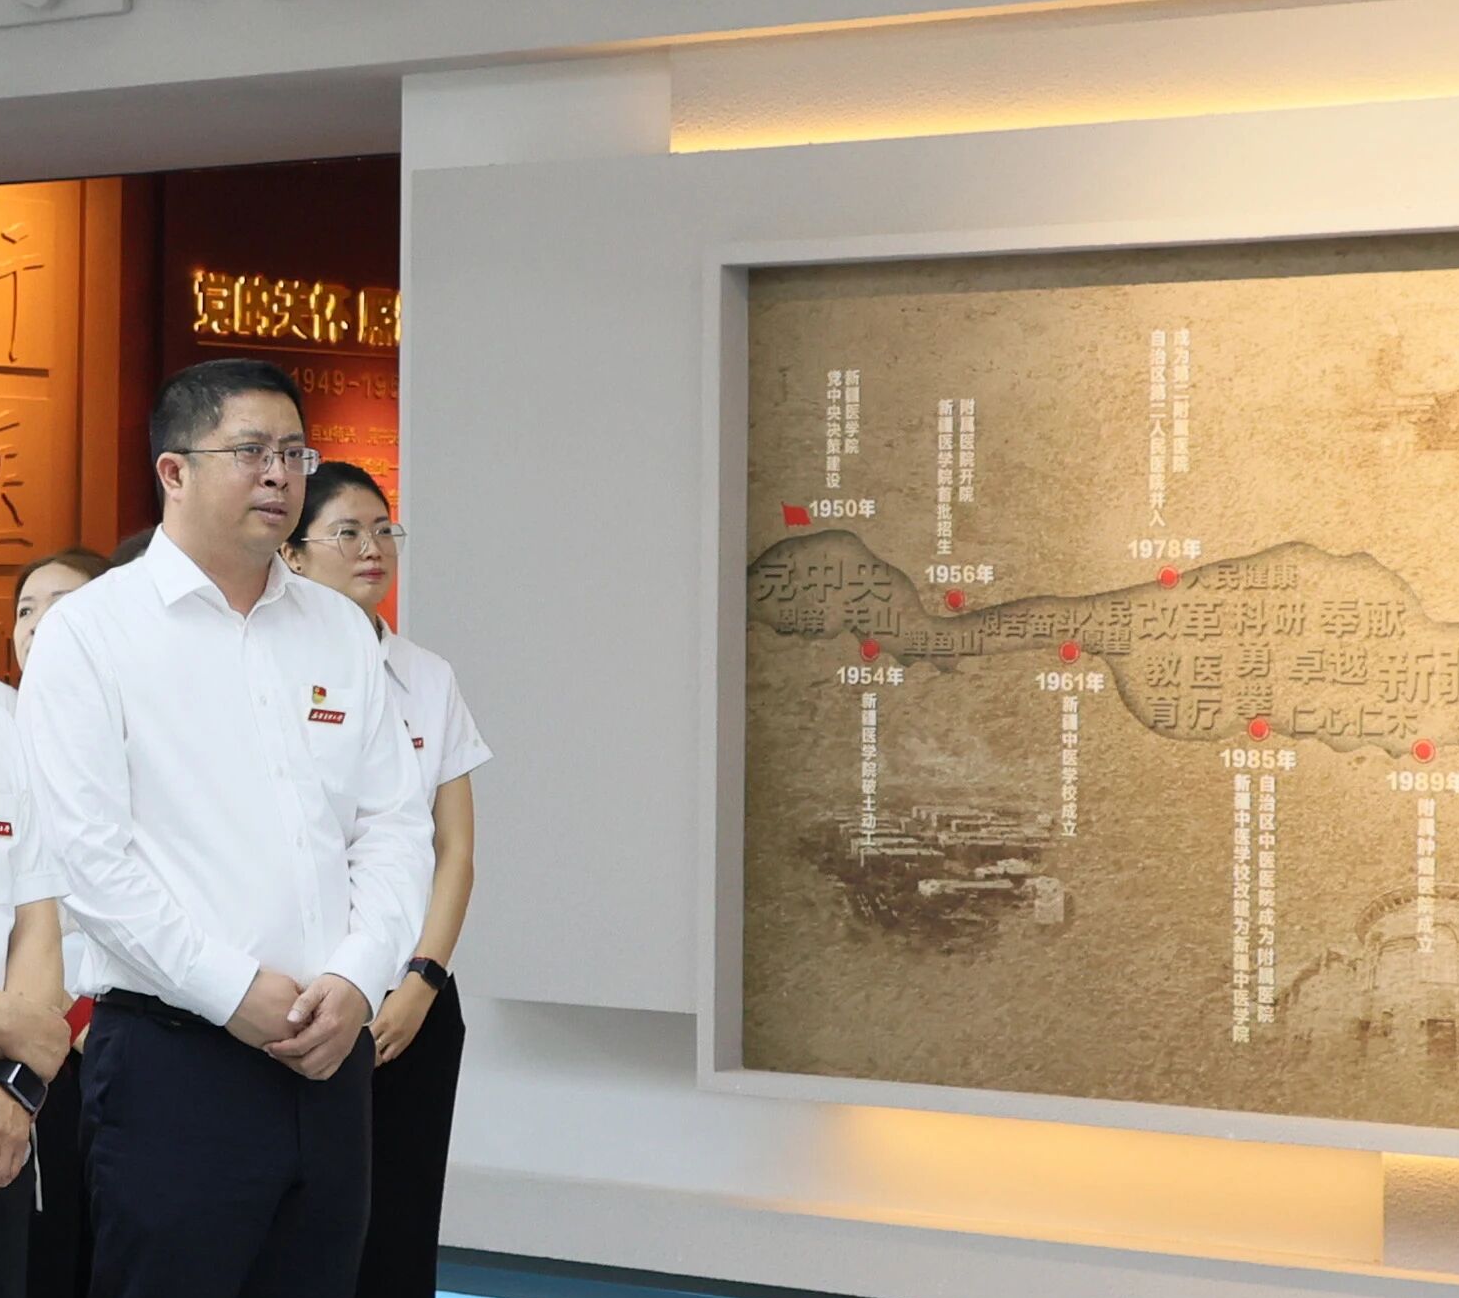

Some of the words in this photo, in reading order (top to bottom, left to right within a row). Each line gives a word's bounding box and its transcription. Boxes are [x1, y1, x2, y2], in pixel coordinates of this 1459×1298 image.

[809, 498, 876, 518] 1950年
[1128, 539, 1202, 560] 1978年
[925, 564, 994, 585] 1956年
[836, 666, 905, 687] 1954年
[1035, 672, 1105, 693] 1961年
[1061, 695, 1079, 837] 新疆中医学校成立
[1220, 749, 1297, 771] 1985年
